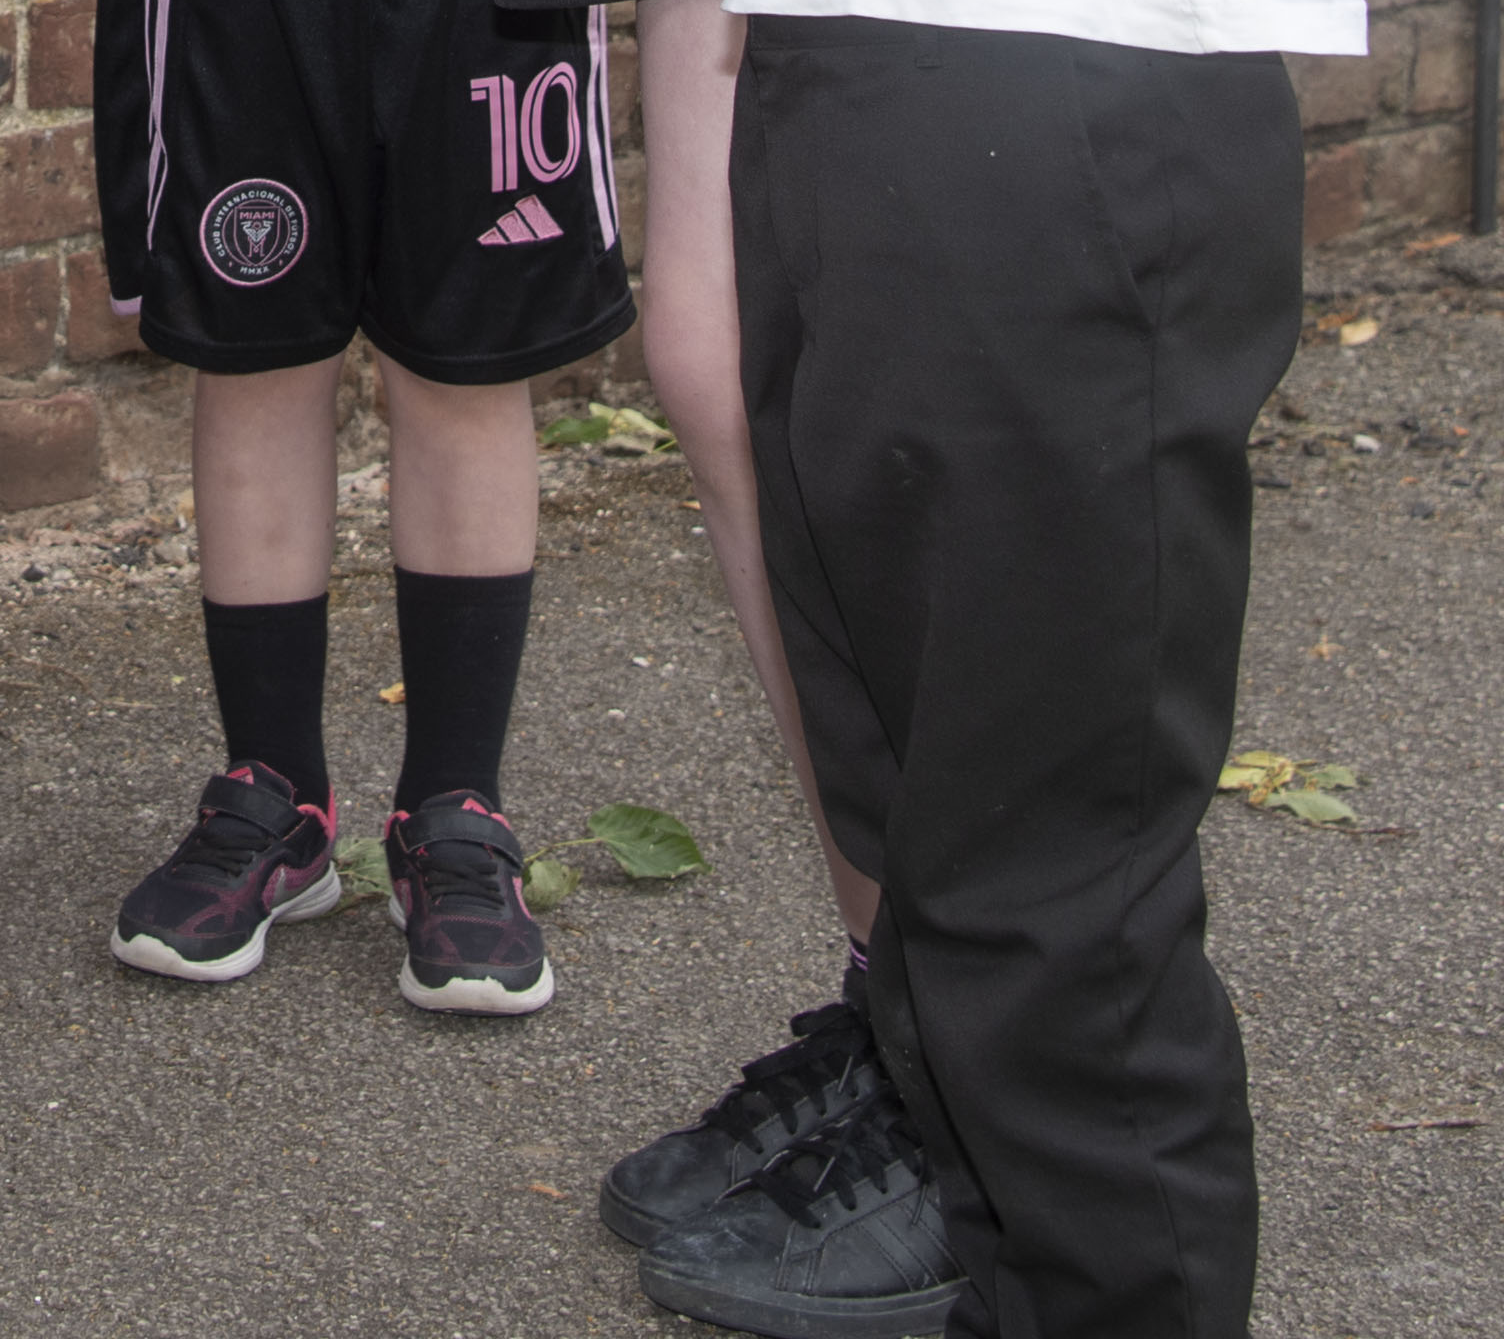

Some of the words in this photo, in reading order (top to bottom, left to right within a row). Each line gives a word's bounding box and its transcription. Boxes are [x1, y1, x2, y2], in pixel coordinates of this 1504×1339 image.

[470, 61, 581, 193] 10
[214, 190, 285, 227] INTERNACIONAL
[239, 211, 275, 220] MIAMI
[285, 205, 296, 218] DE
[213, 231, 225, 257] CLUB
[240, 266, 270, 275] MMXX
